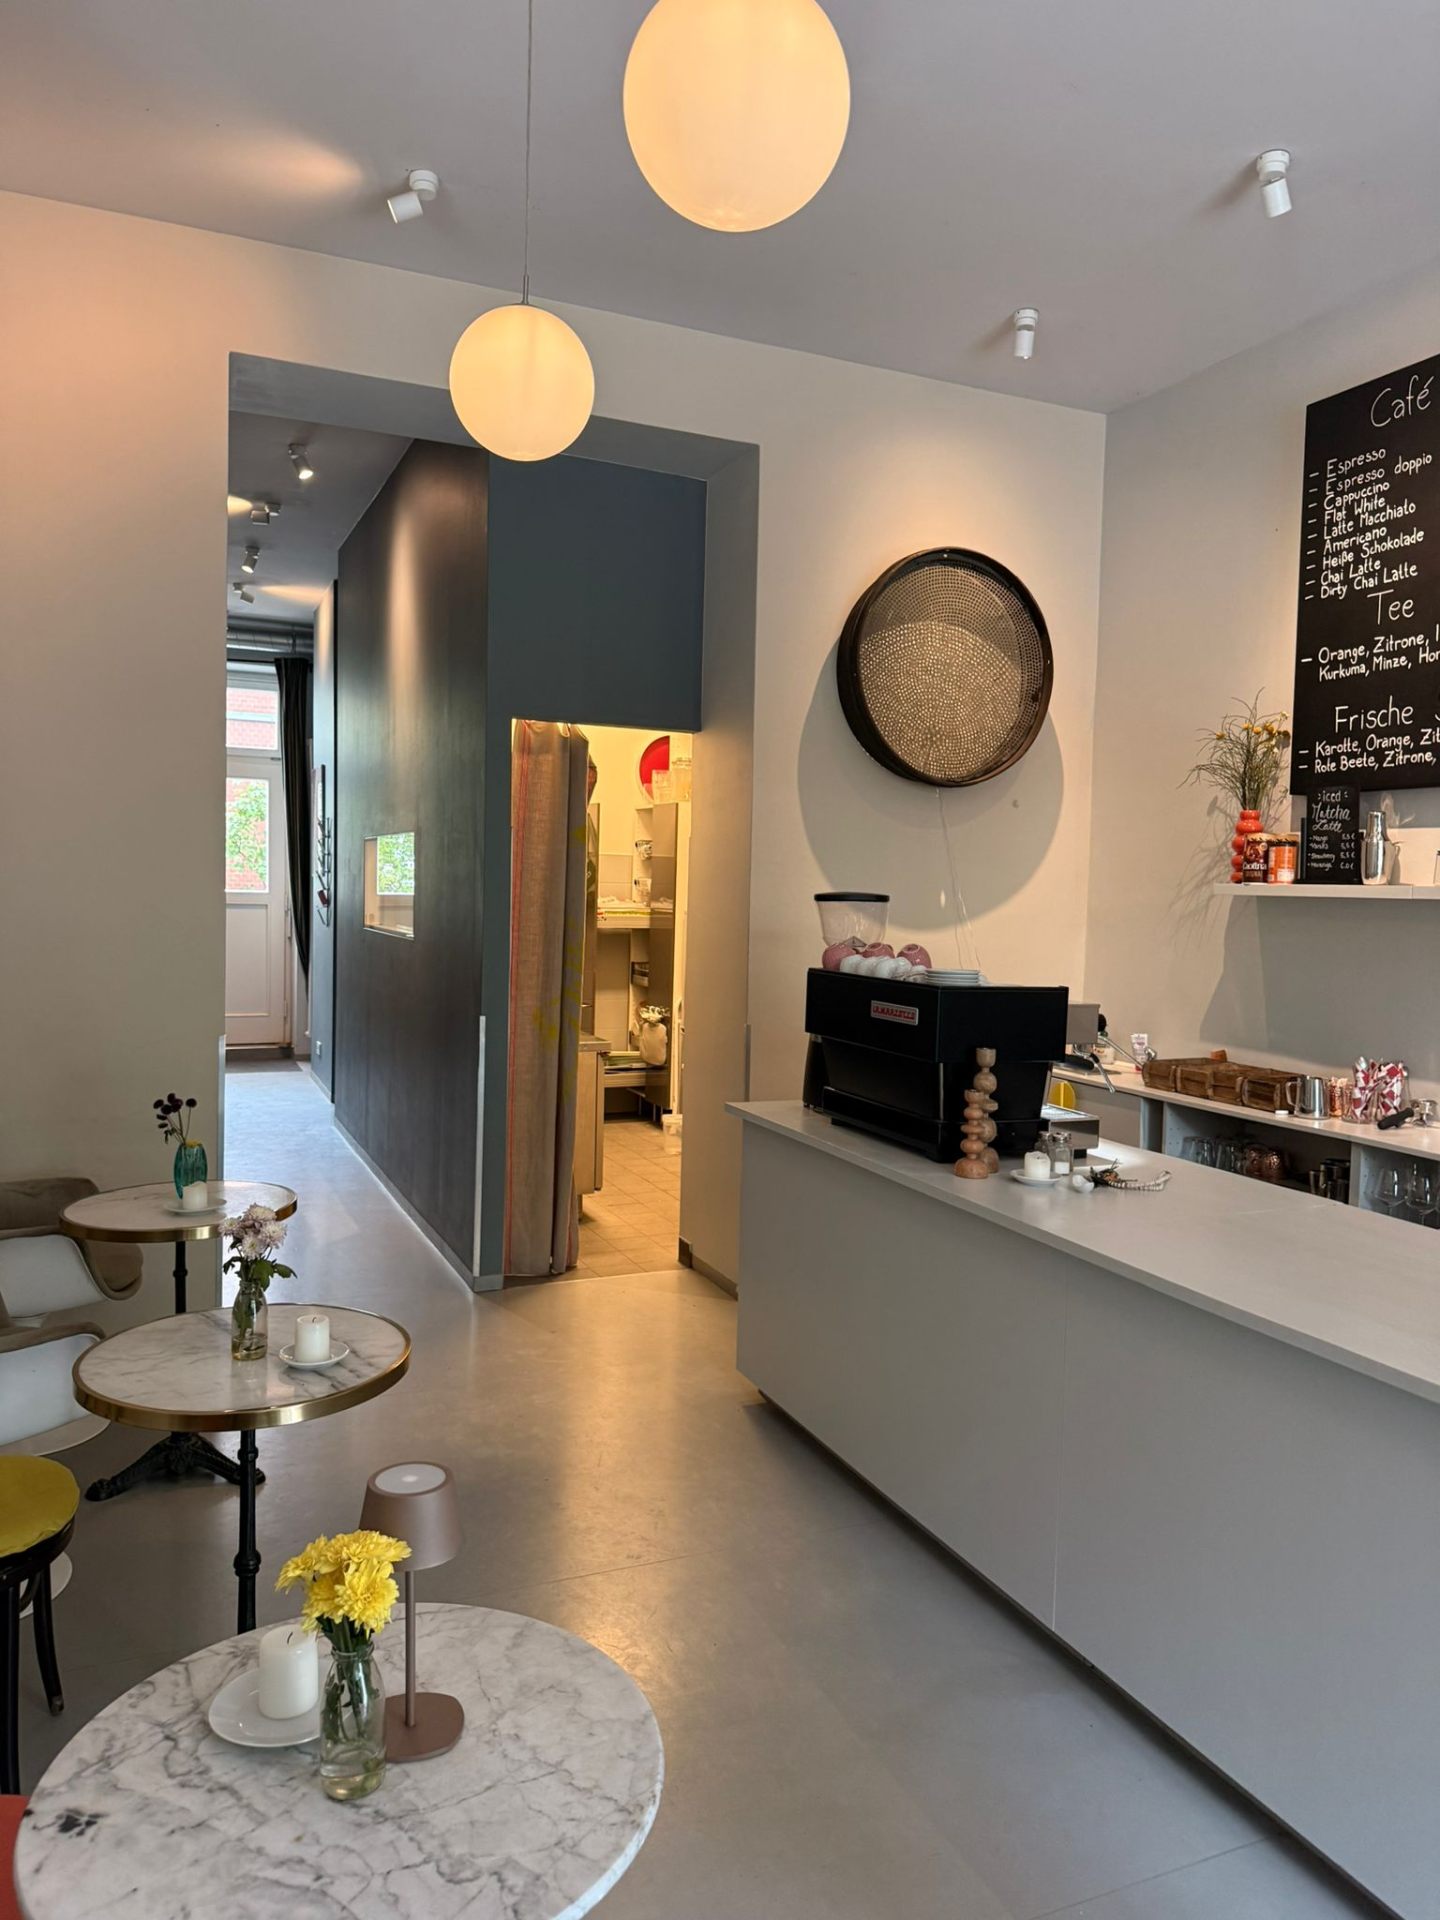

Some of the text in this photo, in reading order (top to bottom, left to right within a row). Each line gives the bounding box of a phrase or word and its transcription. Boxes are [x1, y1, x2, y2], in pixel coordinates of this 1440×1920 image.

[1370, 374, 1435, 428] Café
[1325, 453, 1432, 495] Espresso doppio
[1326, 448, 1386, 478] Espresso
[1323, 482, 1390, 510] Cappuccino
[1324, 494, 1386, 525] Flat White
[1323, 498, 1416, 540] Latte Macchiato
[1322, 526, 1425, 570] Heiße Schokolade
[1323, 526, 1387, 555] Americano
[1320, 557, 1381, 586] Chai Latte
[1320, 561, 1418, 600] Dirty Chai Latte
[1366, 589, 1415, 625] Tee
[1318, 645, 1370, 665] Orange,
[1373, 633, 1430, 654] Zitrone,
[1319, 662, 1371, 682] Kurkuma,
[1372, 655, 1413, 672] Minze,
[1335, 695, 1415, 733] Frische
[1315, 737, 1362, 758] Karotte,
[1366, 733, 1414, 752] Orange,
[1314, 750, 1437, 774] Rote Beete, Zitrone,
[1322, 790, 1341, 802] iced
[1311, 802, 1351, 822] Matcha
[1312, 819, 1343, 833] Latte
